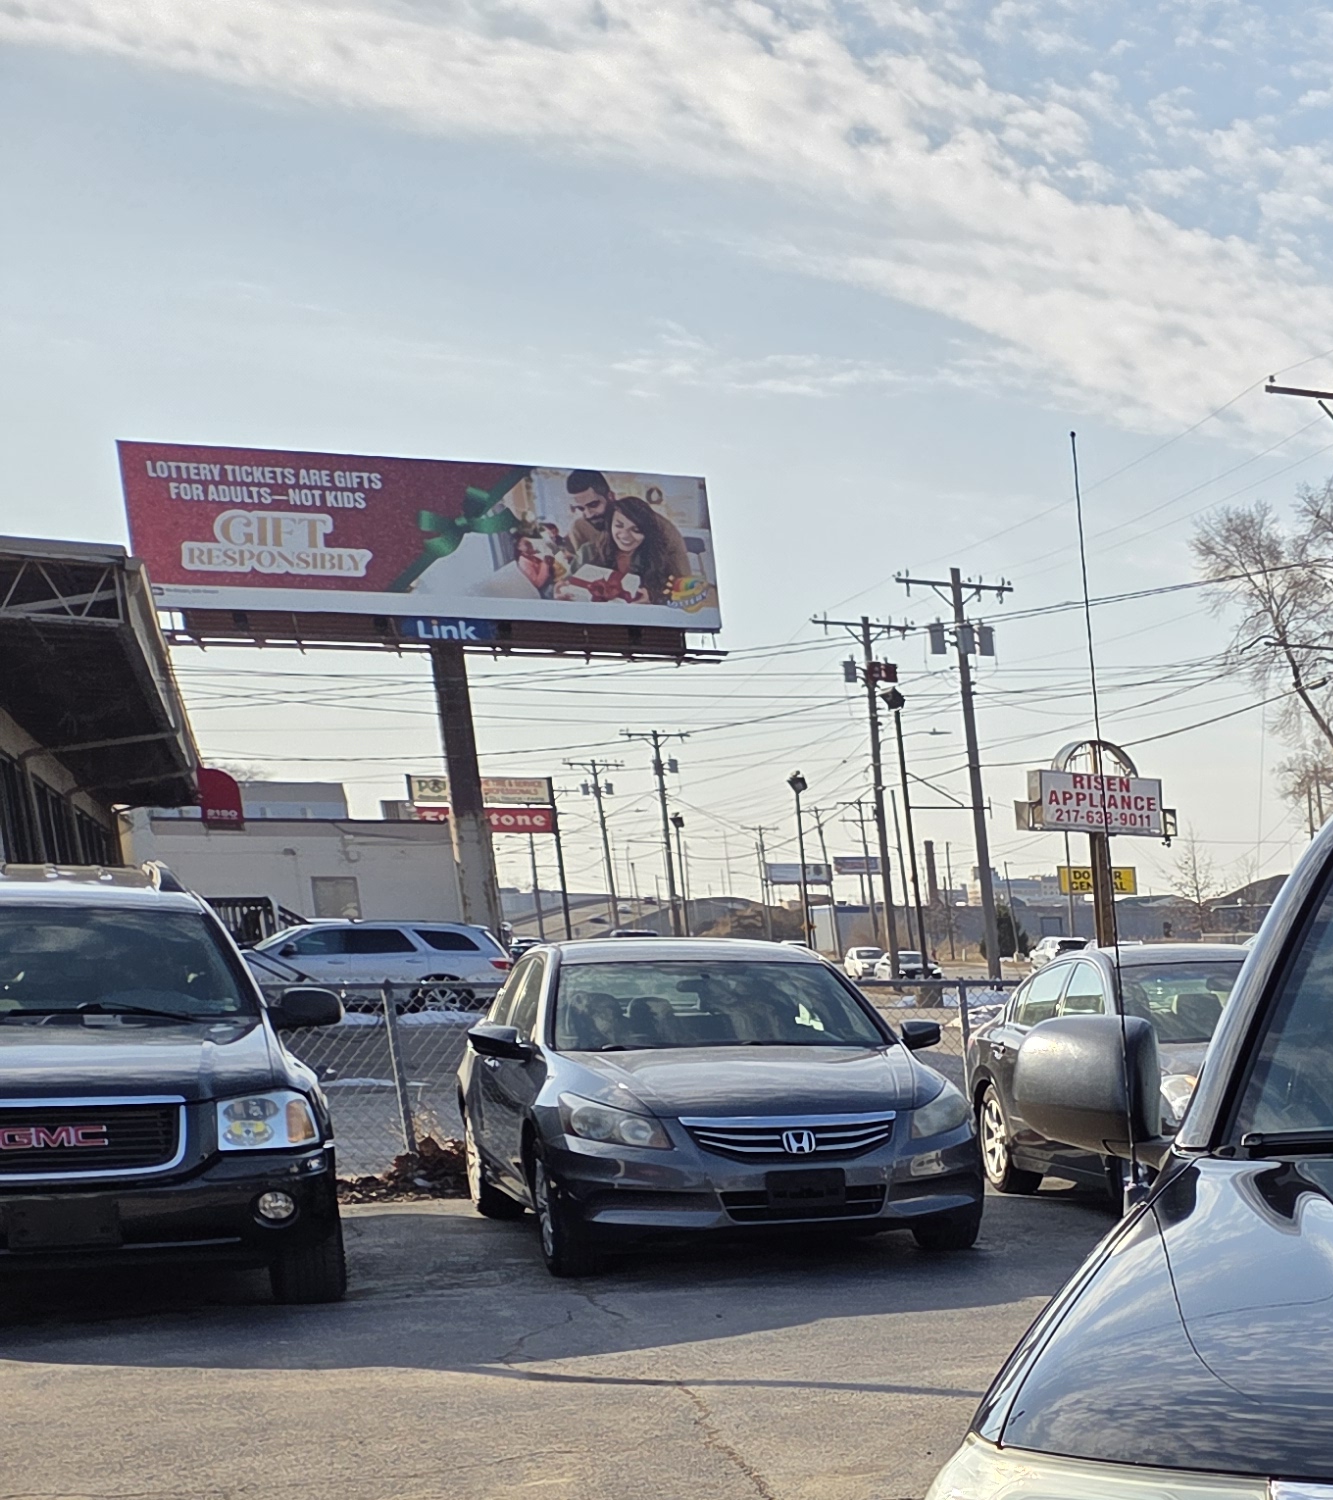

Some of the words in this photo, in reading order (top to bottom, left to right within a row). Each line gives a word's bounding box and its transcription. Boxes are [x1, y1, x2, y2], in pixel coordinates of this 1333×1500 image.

[146, 461, 220, 480] LOTTERY
[224, 465, 296, 484] TICKETS
[299, 469, 332, 486] ARE
[333, 471, 382, 489] GIFTS
[169, 482, 205, 500] FOR
[325, 491, 367, 509] KIDS
[220, 515, 327, 548] GIFT
[187, 547, 367, 571] RESPONSIBLY
[417, 620, 480, 640] Link
[1072, 774, 1130, 793] RISEN
[1048, 790, 1157, 812] APPLIANCE
[0, 1125, 109, 1149] GMC
